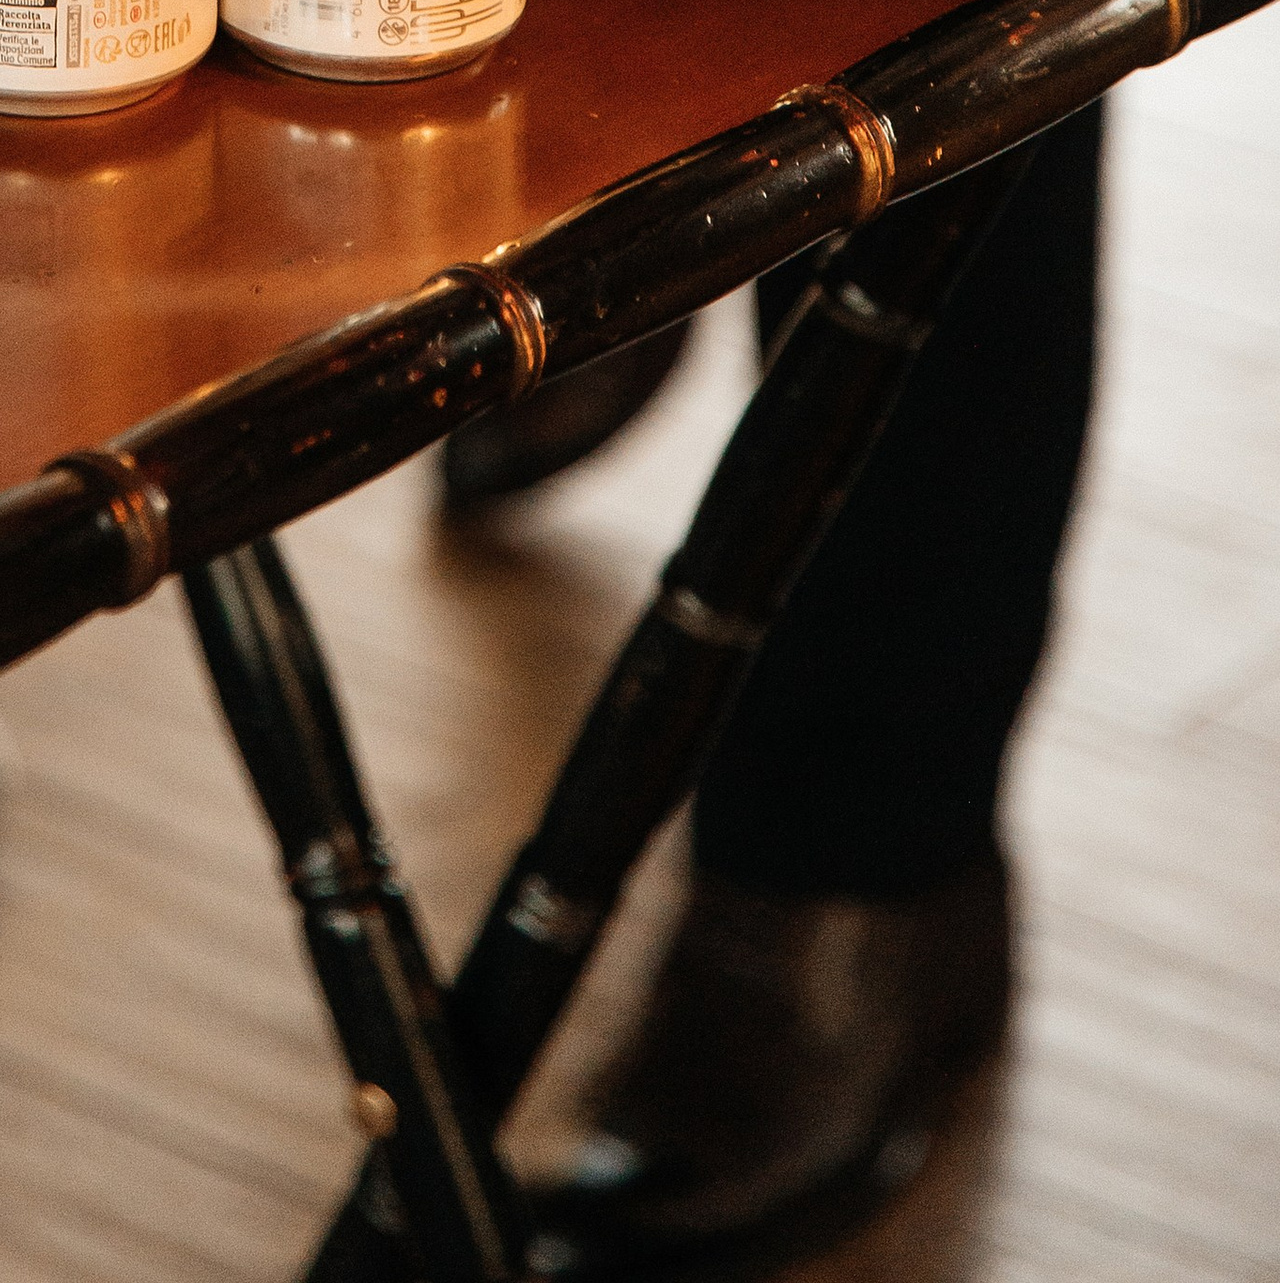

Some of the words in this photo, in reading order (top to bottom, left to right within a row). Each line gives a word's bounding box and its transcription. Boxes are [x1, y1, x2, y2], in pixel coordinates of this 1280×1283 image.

[31, 36, 40, 45] le
[0, 52, 16, 63] tuo
[17, 54, 55, 65] Comune
